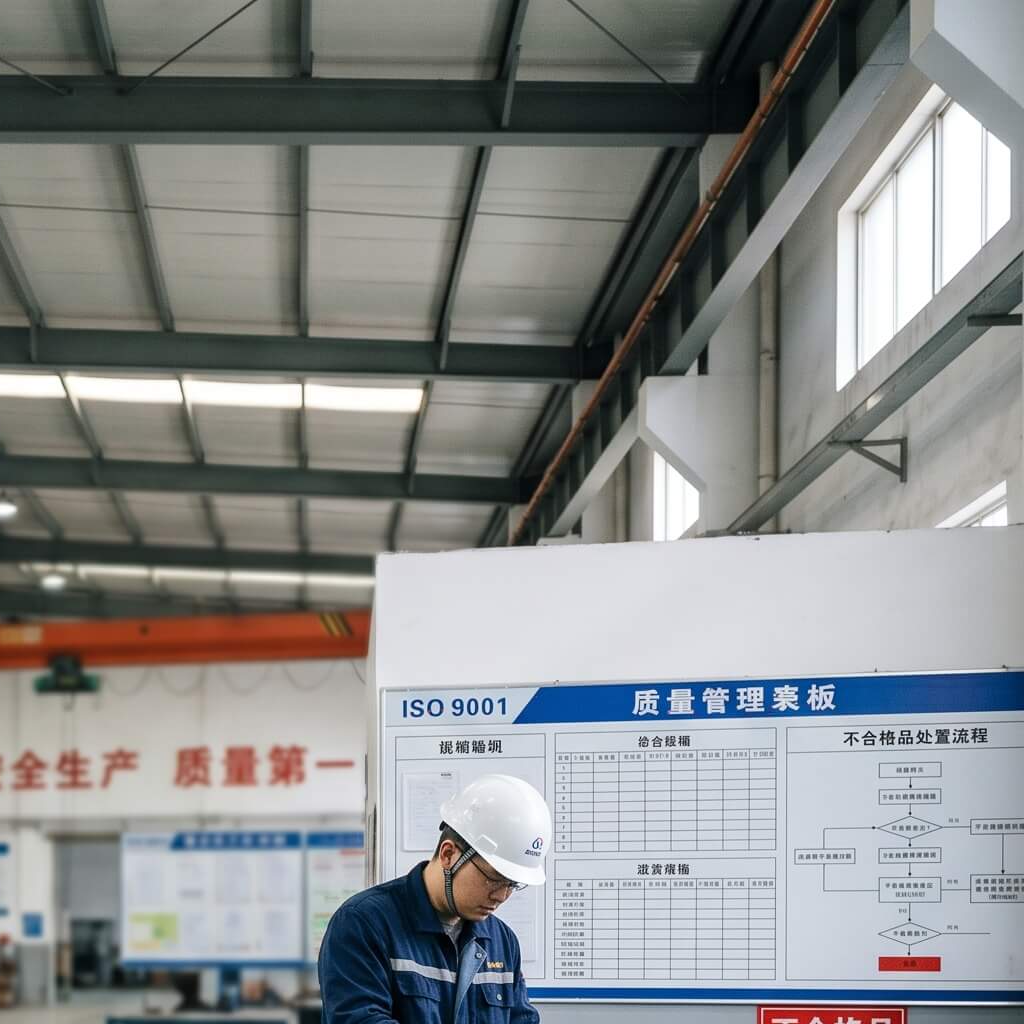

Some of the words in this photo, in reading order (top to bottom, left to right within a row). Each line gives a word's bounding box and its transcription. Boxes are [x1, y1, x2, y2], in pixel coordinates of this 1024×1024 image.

[402, 698, 444, 718] ISO
[451, 697, 506, 716] 9001
[173, 745, 355, 787] 质量第一
